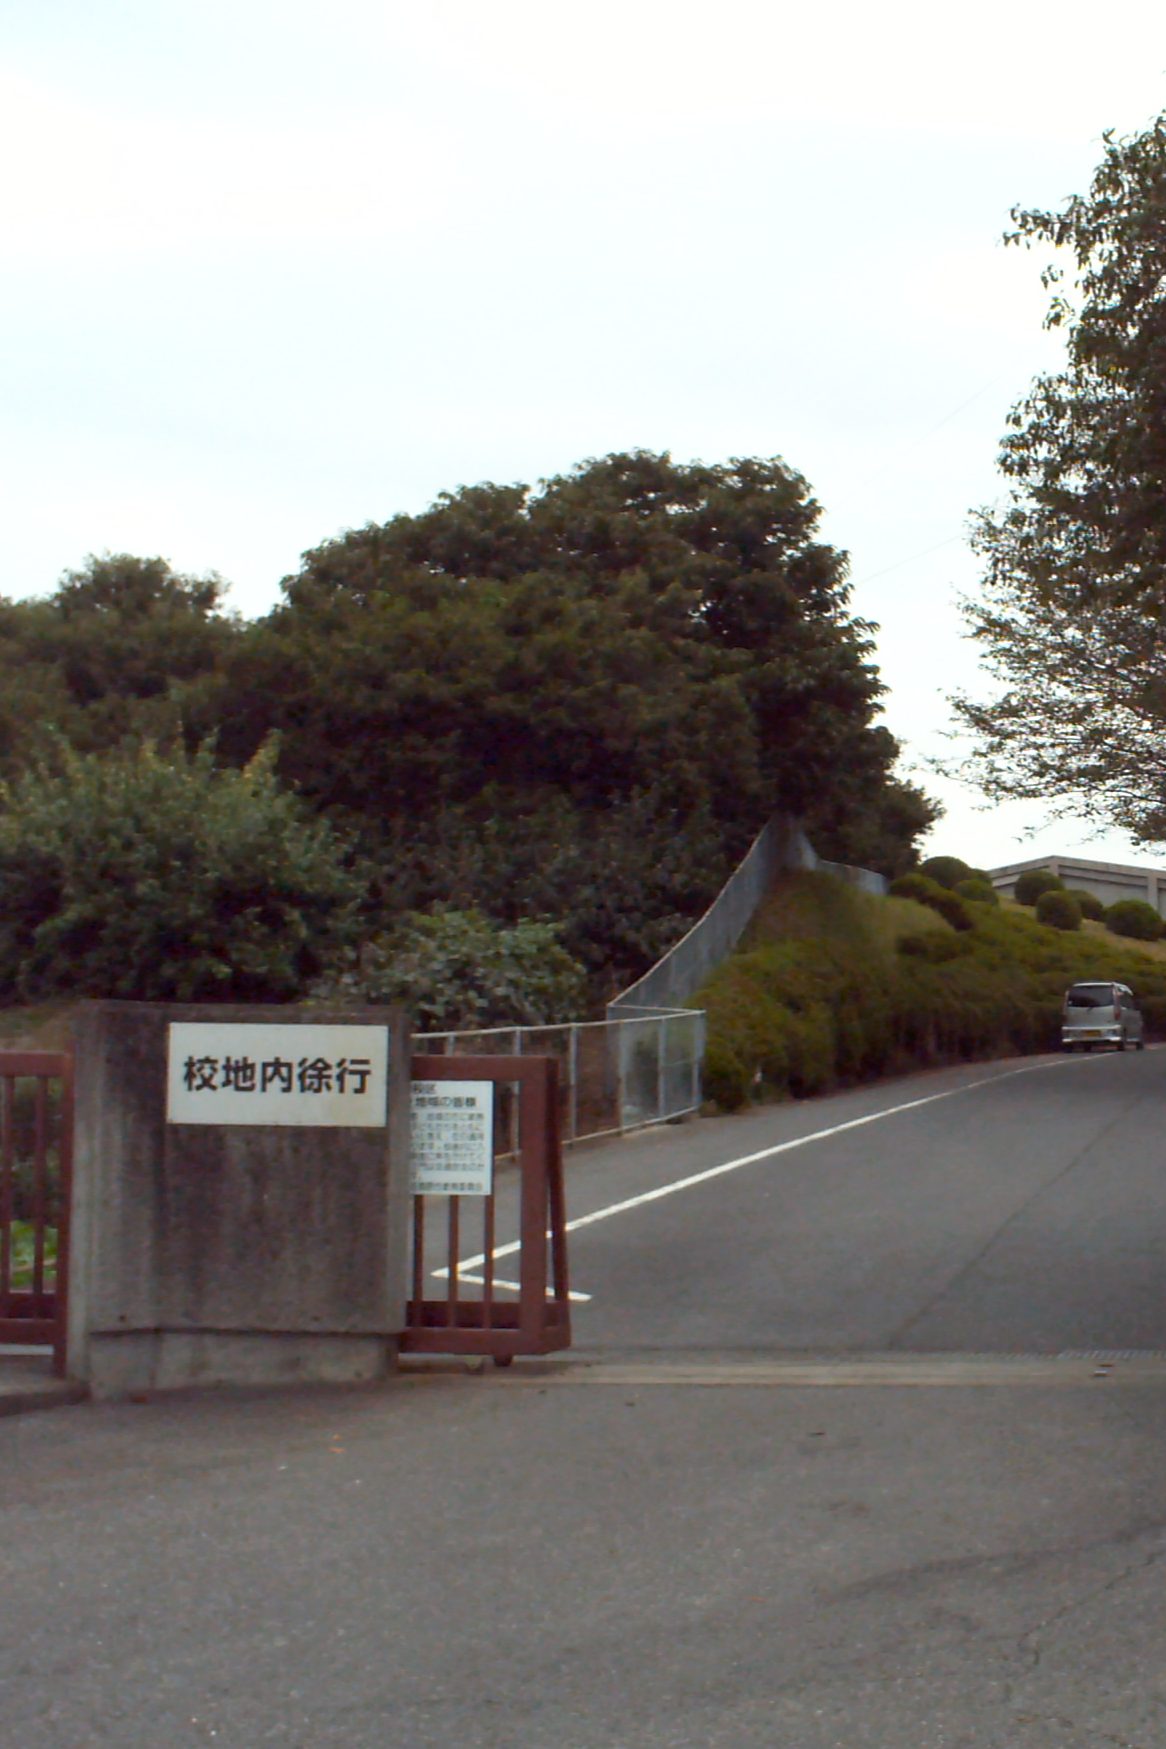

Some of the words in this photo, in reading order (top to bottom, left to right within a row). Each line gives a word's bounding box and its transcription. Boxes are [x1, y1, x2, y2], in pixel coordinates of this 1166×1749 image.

[183, 1056, 371, 1094] 校地内徐行
